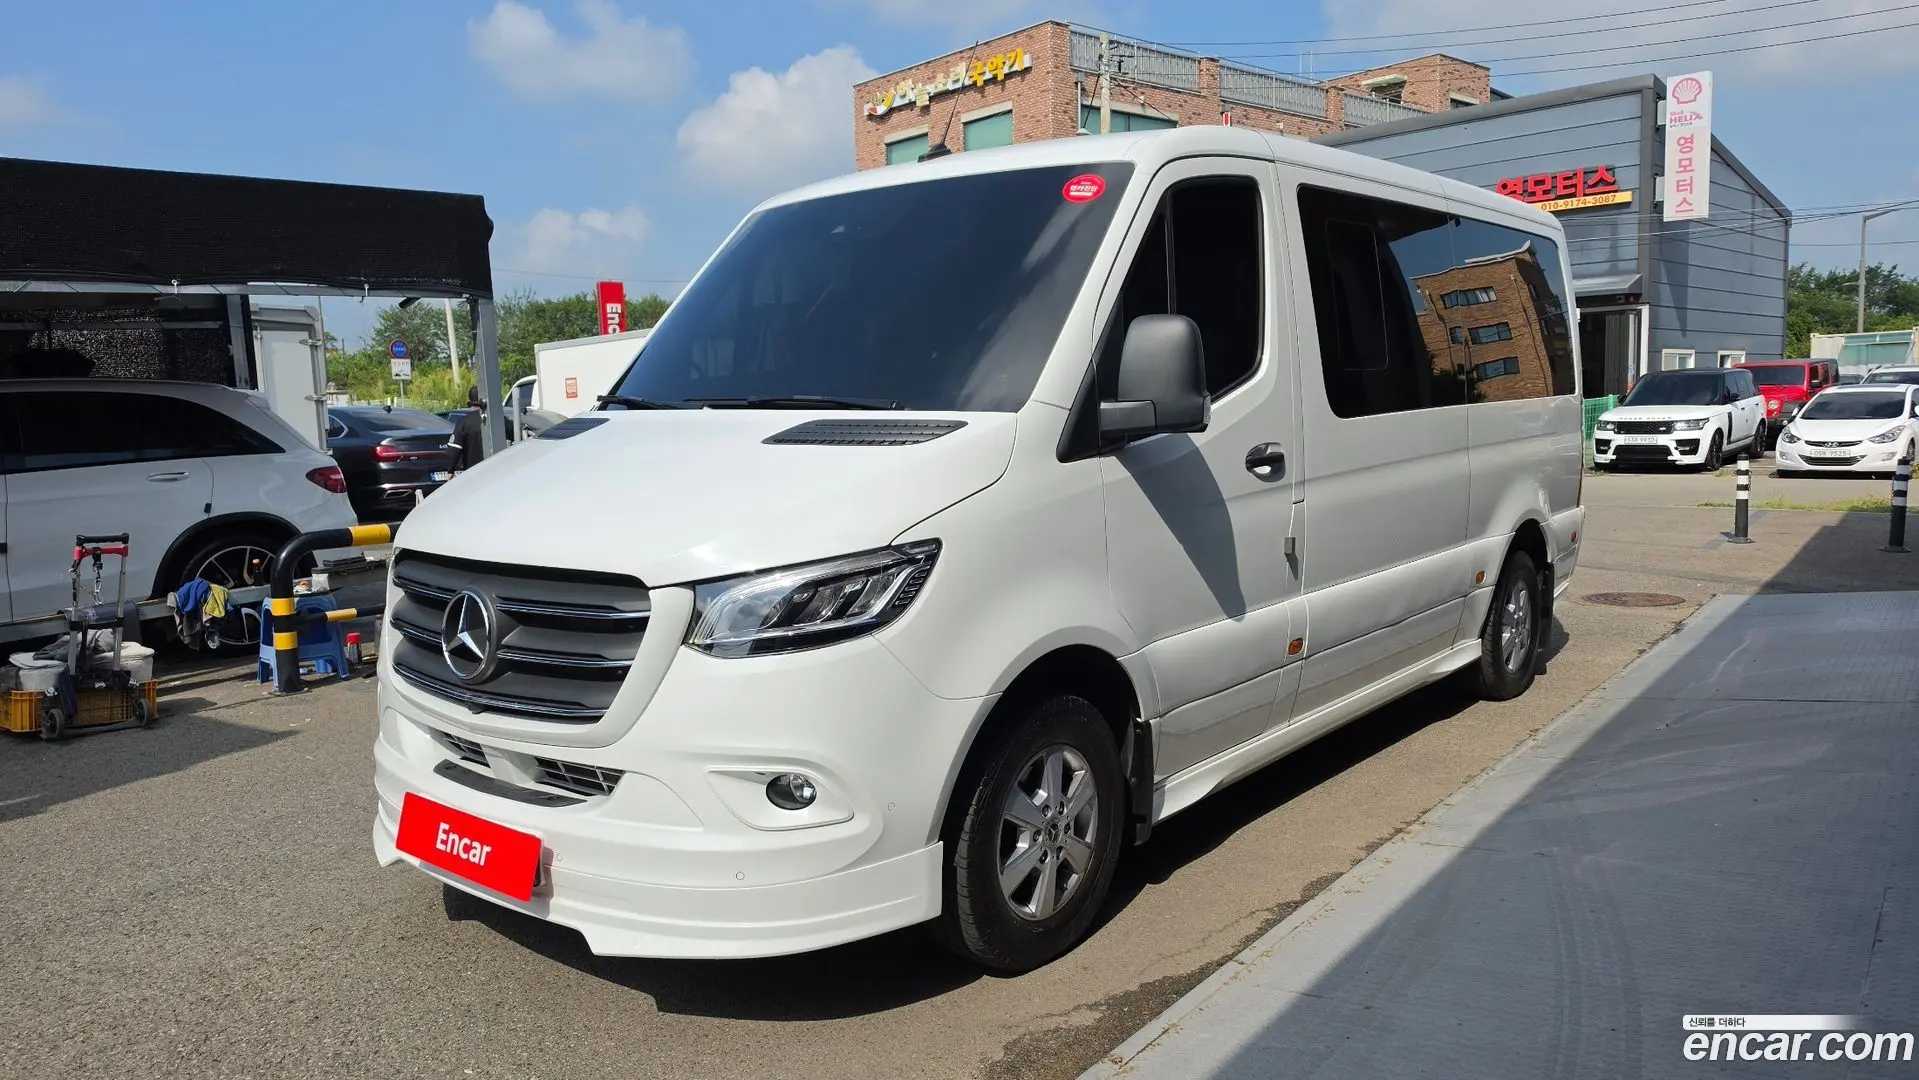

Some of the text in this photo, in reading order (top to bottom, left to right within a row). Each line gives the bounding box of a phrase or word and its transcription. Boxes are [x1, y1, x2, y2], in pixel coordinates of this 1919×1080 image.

[969, 47, 1025, 87] 국악기
[1496, 165, 1619, 203] 영모터스
[1675, 134, 1695, 213] 영모터스
[1541, 194, 1617, 211] 010-9174-3087
[435, 822, 493, 867] Encar
